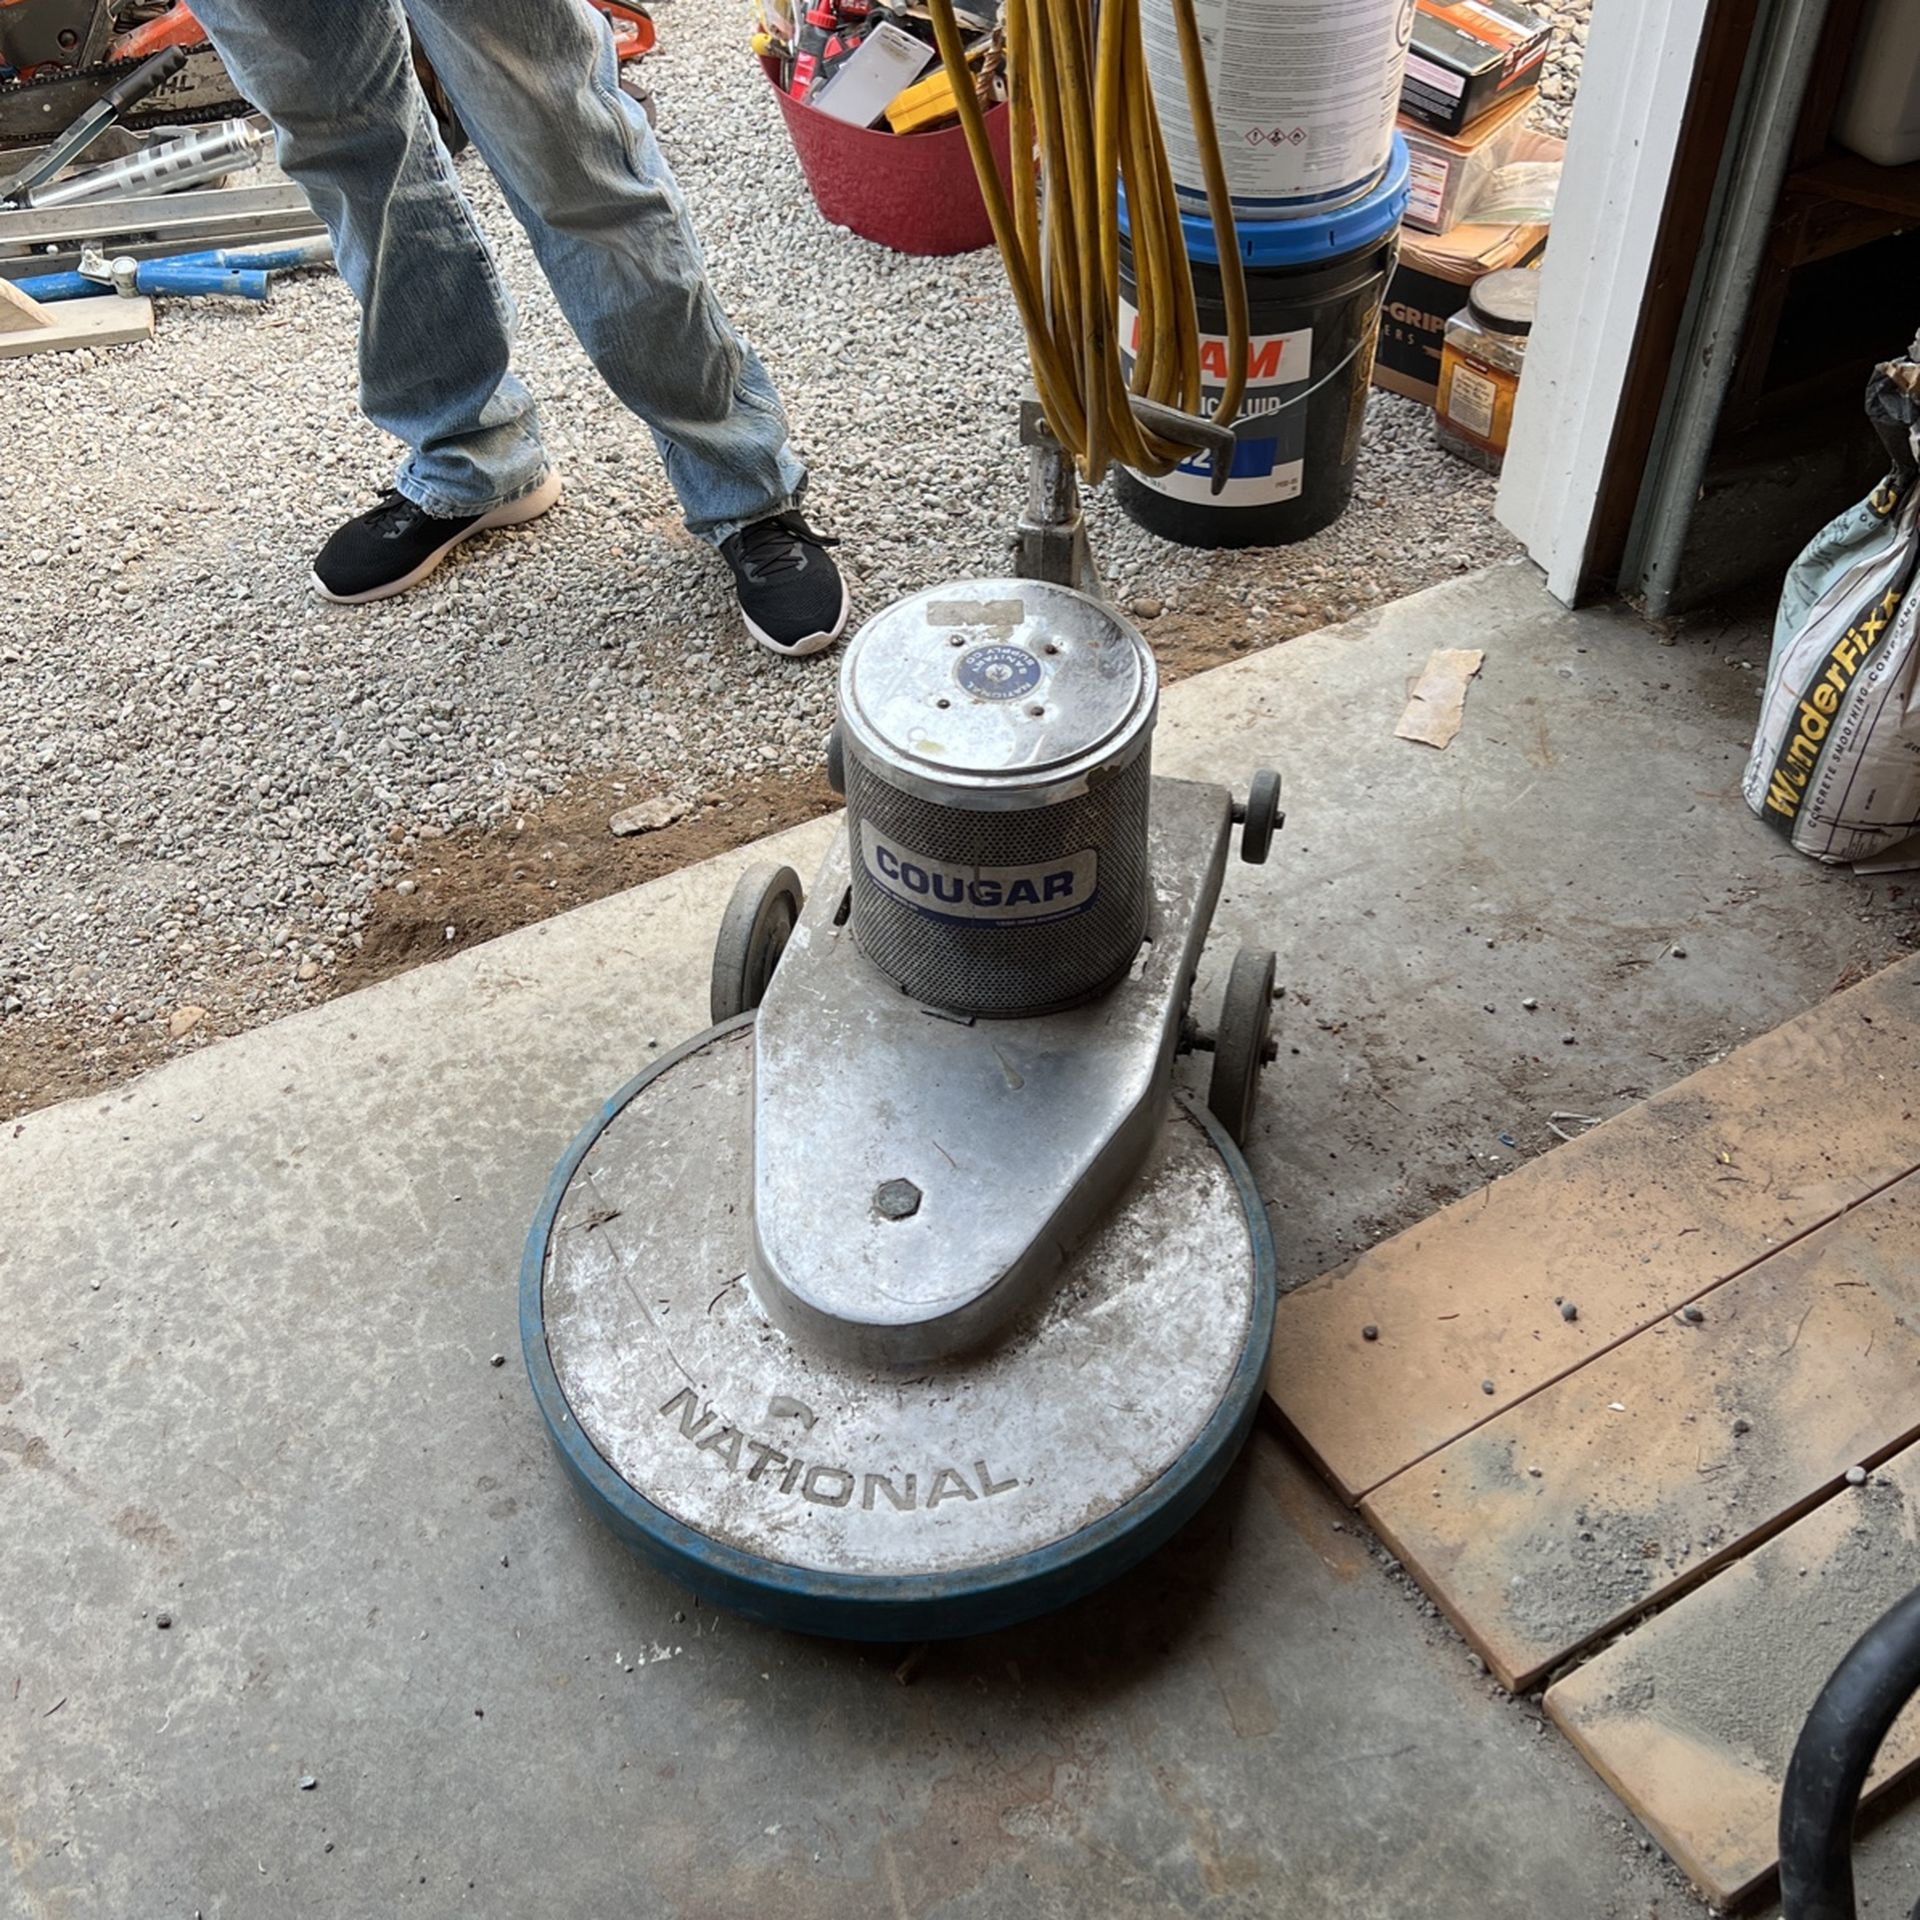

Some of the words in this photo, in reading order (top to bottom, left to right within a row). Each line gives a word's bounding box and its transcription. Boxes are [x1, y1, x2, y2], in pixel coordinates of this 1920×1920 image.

[971, 654, 1028, 675] SANITARY
[986, 647, 1035, 666] SUPPLY
[966, 681, 1032, 699] NATIONAL
[1766, 587, 1902, 818] WunderFixx
[1807, 765, 1837, 829] CONCRETE
[1832, 687, 1869, 763] SMOOTHING
[1868, 597, 1918, 682] COMPUND
[876, 845, 1075, 907] COUGAR
[659, 1386, 1020, 1511] NATIONAL
